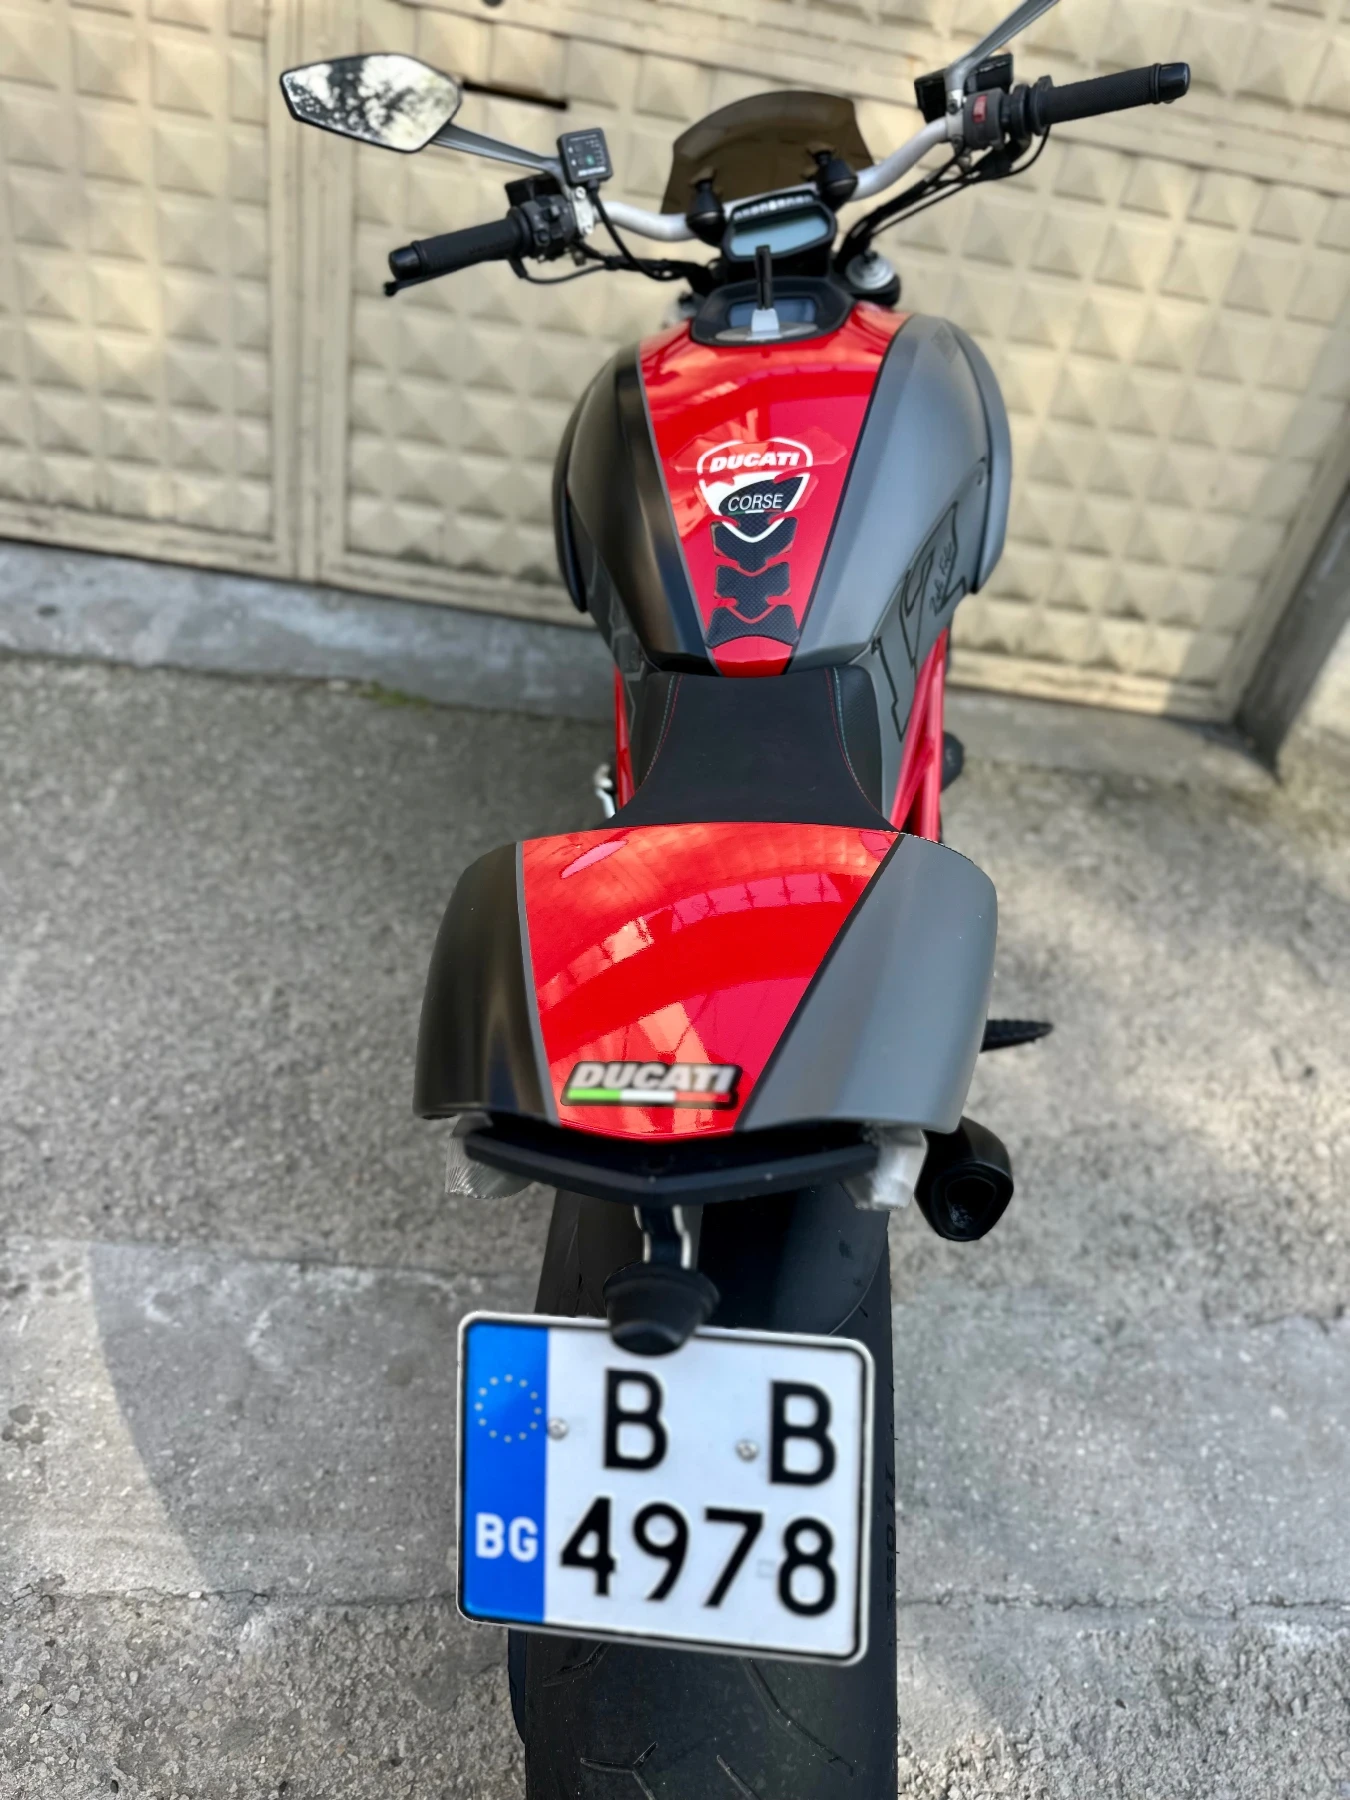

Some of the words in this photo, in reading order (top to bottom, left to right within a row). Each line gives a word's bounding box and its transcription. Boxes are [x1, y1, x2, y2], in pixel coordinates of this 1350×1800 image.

[709, 451, 800, 473] DUCATI
[727, 494, 784, 512] CORSE
[569, 1061, 738, 1092] DUCATI
[603, 1366, 669, 1472] B
[769, 1379, 837, 1487] B
[475, 1512, 538, 1563] BG
[560, 1496, 838, 1618] 4978
